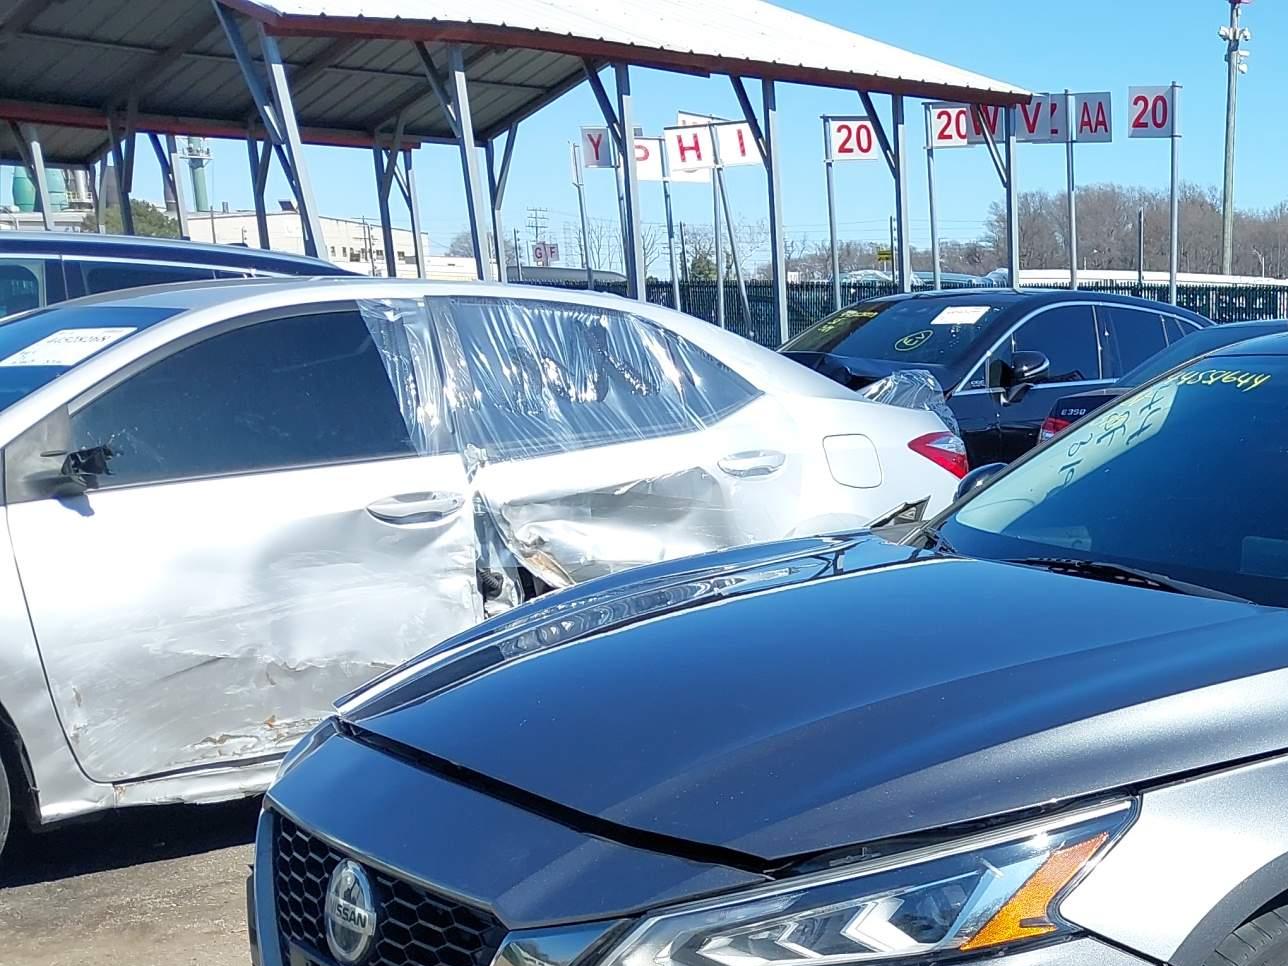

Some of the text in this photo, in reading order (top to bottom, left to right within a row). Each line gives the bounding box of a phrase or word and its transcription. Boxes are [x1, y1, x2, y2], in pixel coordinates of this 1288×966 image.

[936, 109, 967, 140] 20
[1018, 101, 1043, 134] V
[1079, 101, 1109, 134] AA
[1132, 95, 1169, 129] 20
[587, 133, 603, 161] Y
[676, 132, 703, 163] H
[736, 128, 747, 158] I
[837, 124, 873, 154] 20
[534, 246, 544, 260] G
[549, 246, 557, 259] F
[331, 900, 367, 929] SSAN
